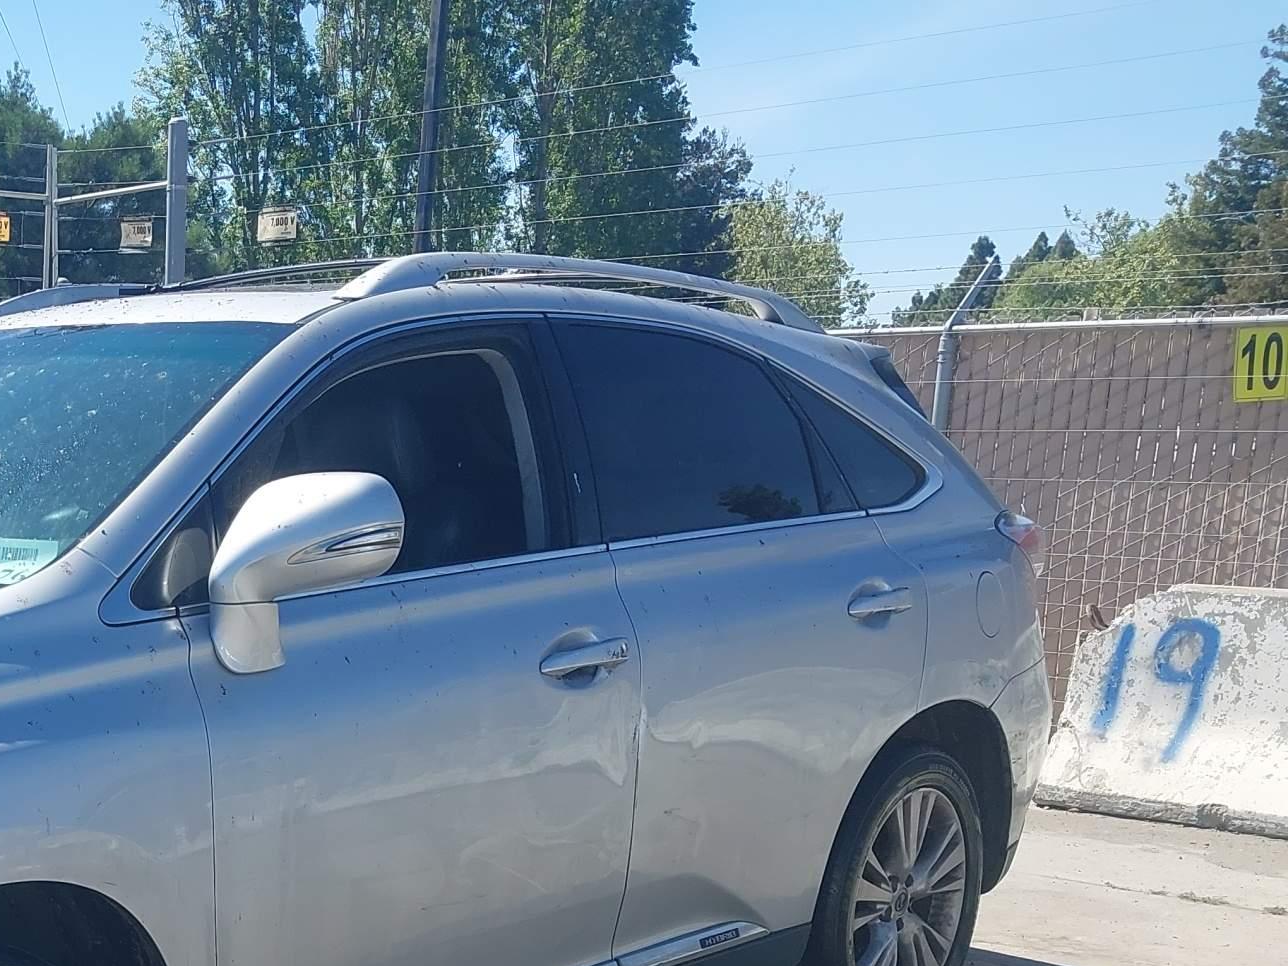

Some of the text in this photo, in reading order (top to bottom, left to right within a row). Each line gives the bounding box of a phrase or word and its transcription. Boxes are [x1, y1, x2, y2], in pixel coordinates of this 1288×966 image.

[290, 215, 295, 225] V
[1241, 332, 1283, 390] 10
[1091, 618, 1221, 763] 19
